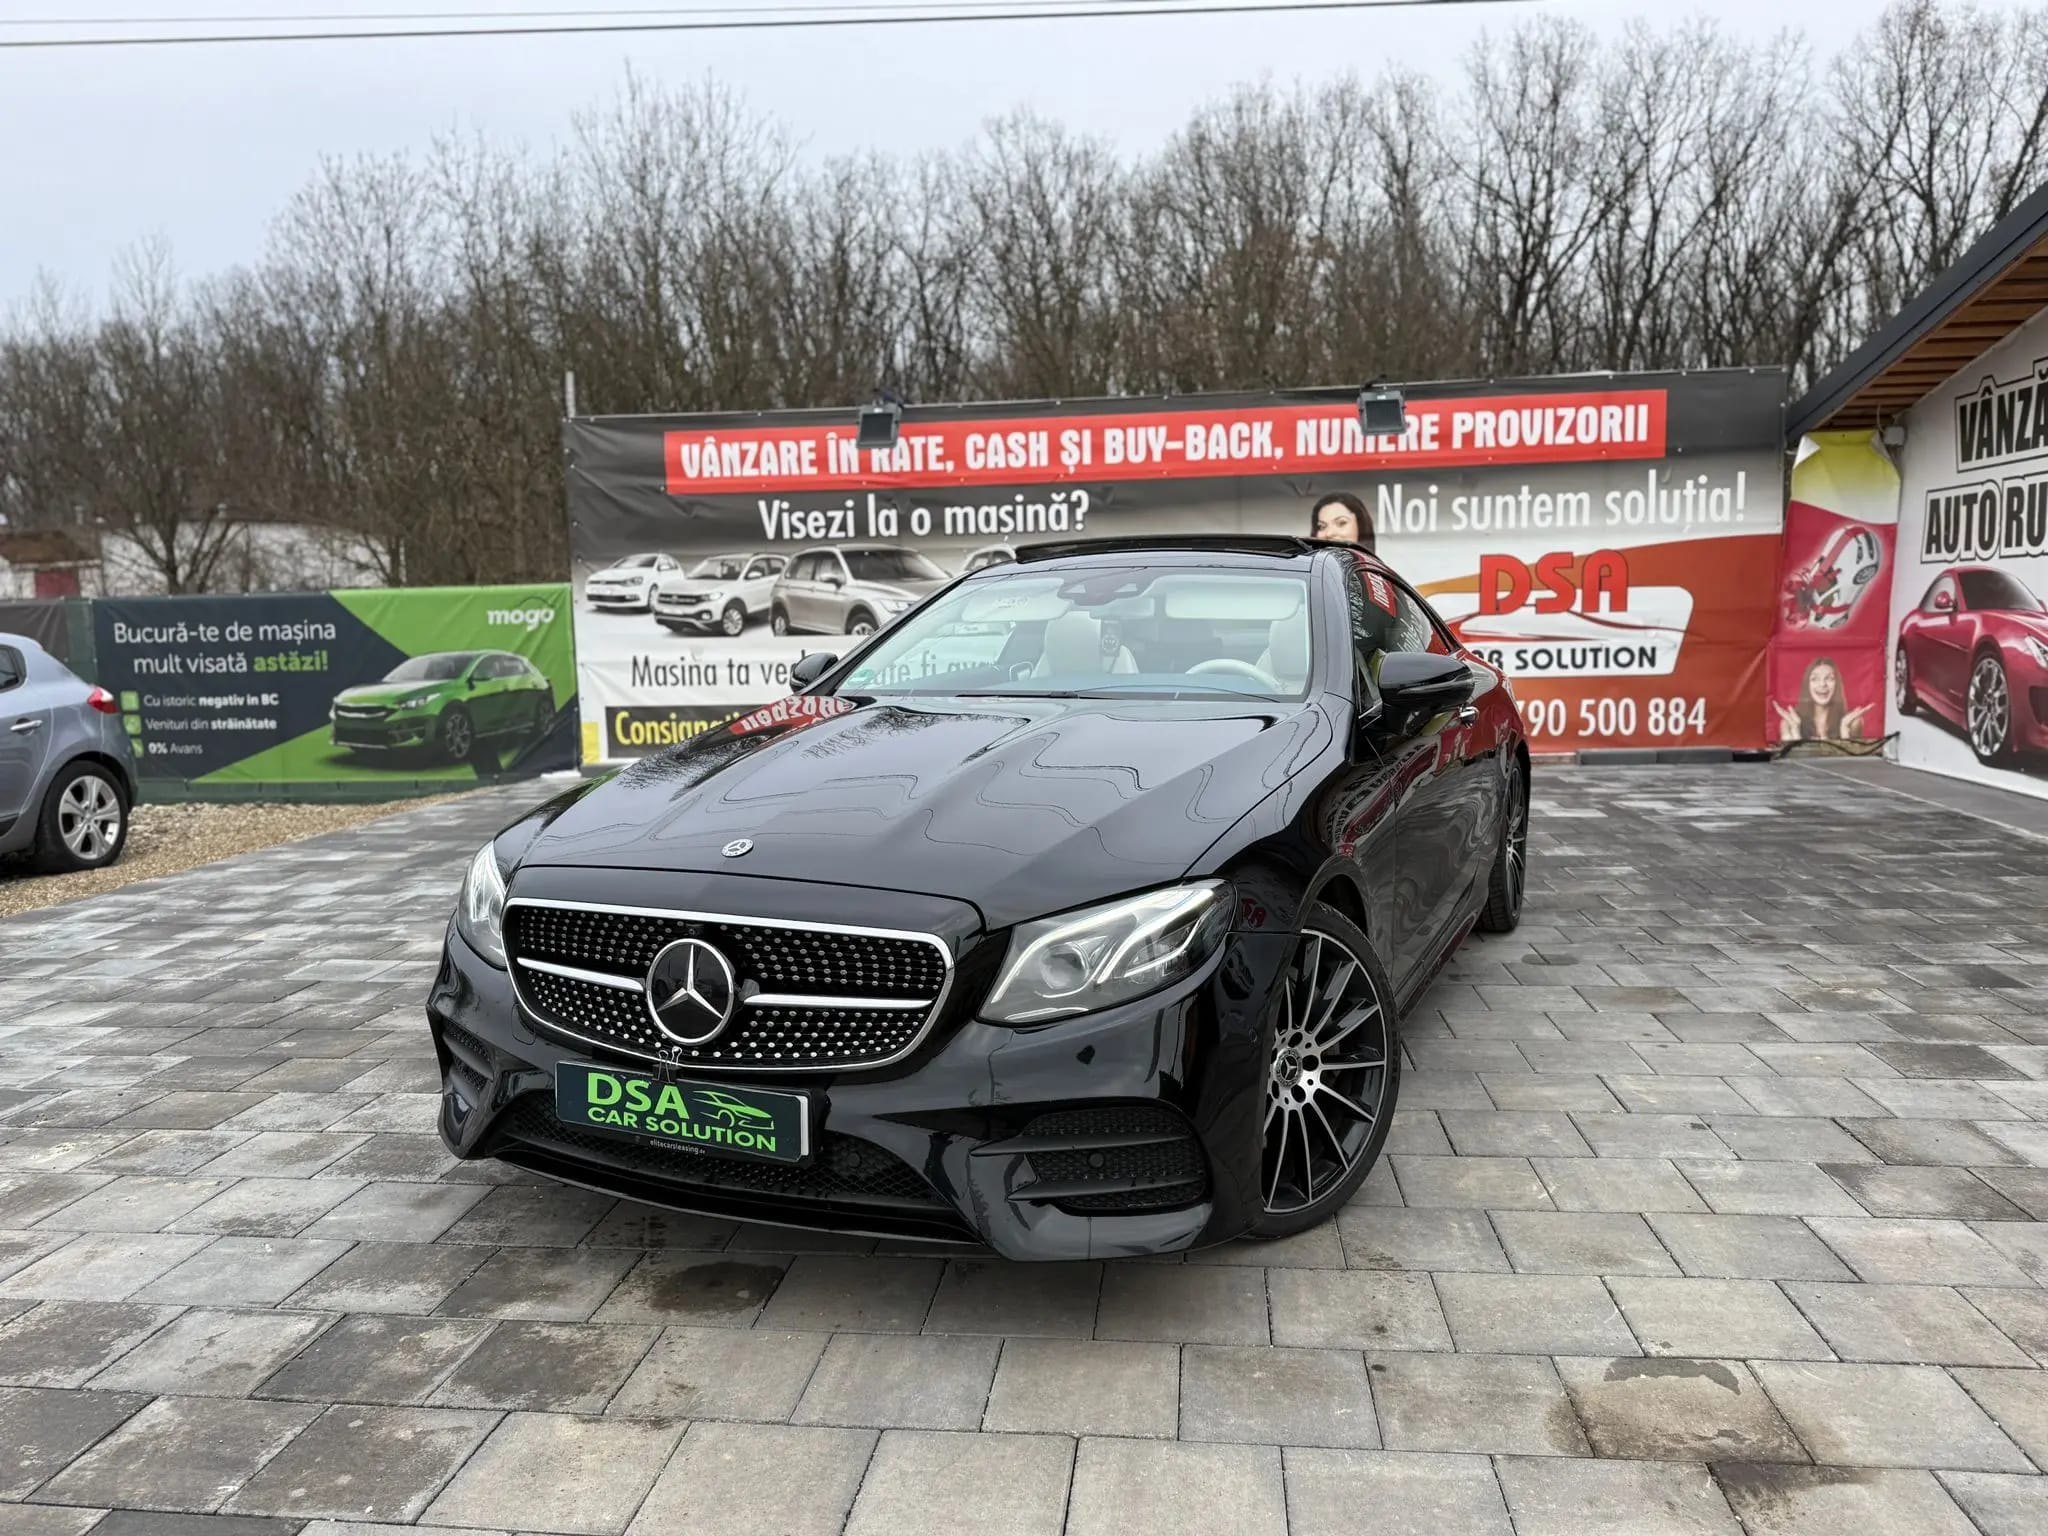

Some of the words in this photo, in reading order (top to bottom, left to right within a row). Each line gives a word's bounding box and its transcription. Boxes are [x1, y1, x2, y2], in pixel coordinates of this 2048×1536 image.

[680, 436, 818, 479] VÂNZARE
[826, 432, 860, 475] ÎN
[965, 431, 1049, 470] CASH
[1060, 429, 1092, 474] ȘI
[1104, 421, 1284, 465] BUY-BACK,
[1452, 404, 1649, 450] PROVIZORII
[758, 499, 855, 540] Visezi
[867, 493, 898, 537] la
[910, 507, 932, 536] o
[1377, 483, 1440, 534] Noi
[1452, 485, 1590, 531] suntem
[1606, 469, 1746, 533] soluția!
[1925, 489, 1997, 554] AUTO
[1479, 549, 1629, 616] DSA
[114, 621, 220, 643] Bucură-te
[225, 620, 253, 642] de
[259, 619, 337, 645] mașina
[487, 608, 555, 632] mogo
[133, 654, 184, 674] mult
[186, 651, 248, 673] visată
[253, 650, 329, 672] astăzi!
[728, 657, 750, 685] ta
[1514, 646, 1657, 670] SOLUTION
[143, 693, 161, 707] Cu
[162, 694, 197, 707] istoric
[198, 694, 245, 709] negativ
[261, 693, 279, 706] BC
[1578, 698, 1637, 737] 500
[1648, 697, 1707, 736] 884
[190, 718, 209, 730] din
[148, 742, 168, 754] 0%
[587, 1072, 690, 1119] DSA
[587, 1107, 639, 1129] CAR
[646, 1118, 776, 1152] SOLUTION
